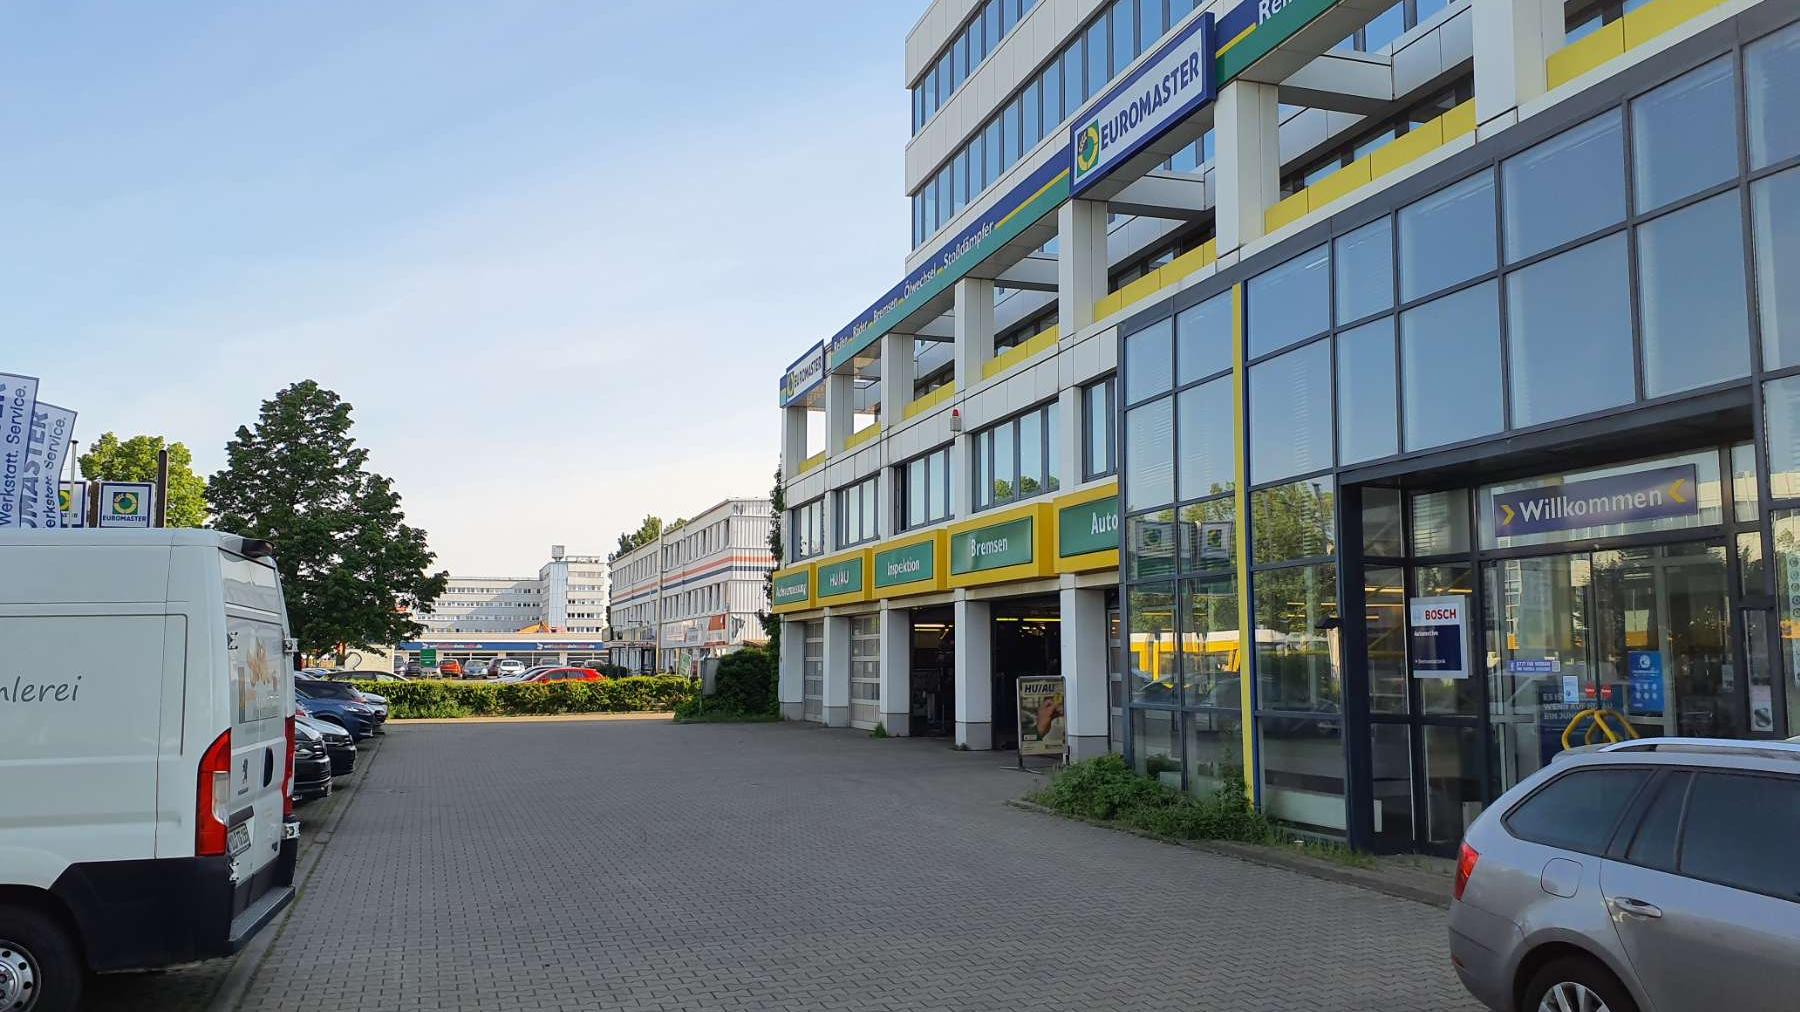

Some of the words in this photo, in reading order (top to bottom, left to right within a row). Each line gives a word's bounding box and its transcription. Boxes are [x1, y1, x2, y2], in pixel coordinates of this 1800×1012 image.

[1101, 51, 1200, 150] EUROMASTER
[903, 262, 937, 299] Ölwechsel
[943, 221, 994, 269] Stoßdämpfer
[6, 385, 28, 445] Service.
[44, 417, 66, 470] Service.
[0, 449, 18, 526] Werkstatt.
[43, 476, 56, 528] erkstatt.
[102, 514, 147, 522] EUROMASTER
[1519, 488, 1663, 522] Willkommen
[1090, 511, 1119, 535] Auto
[971, 536, 1008, 556] Bremsen
[887, 557, 920, 578] Inspektion
[1425, 608, 1457, 620] BOSCH
[1024, 683, 1055, 693] HU/AU
